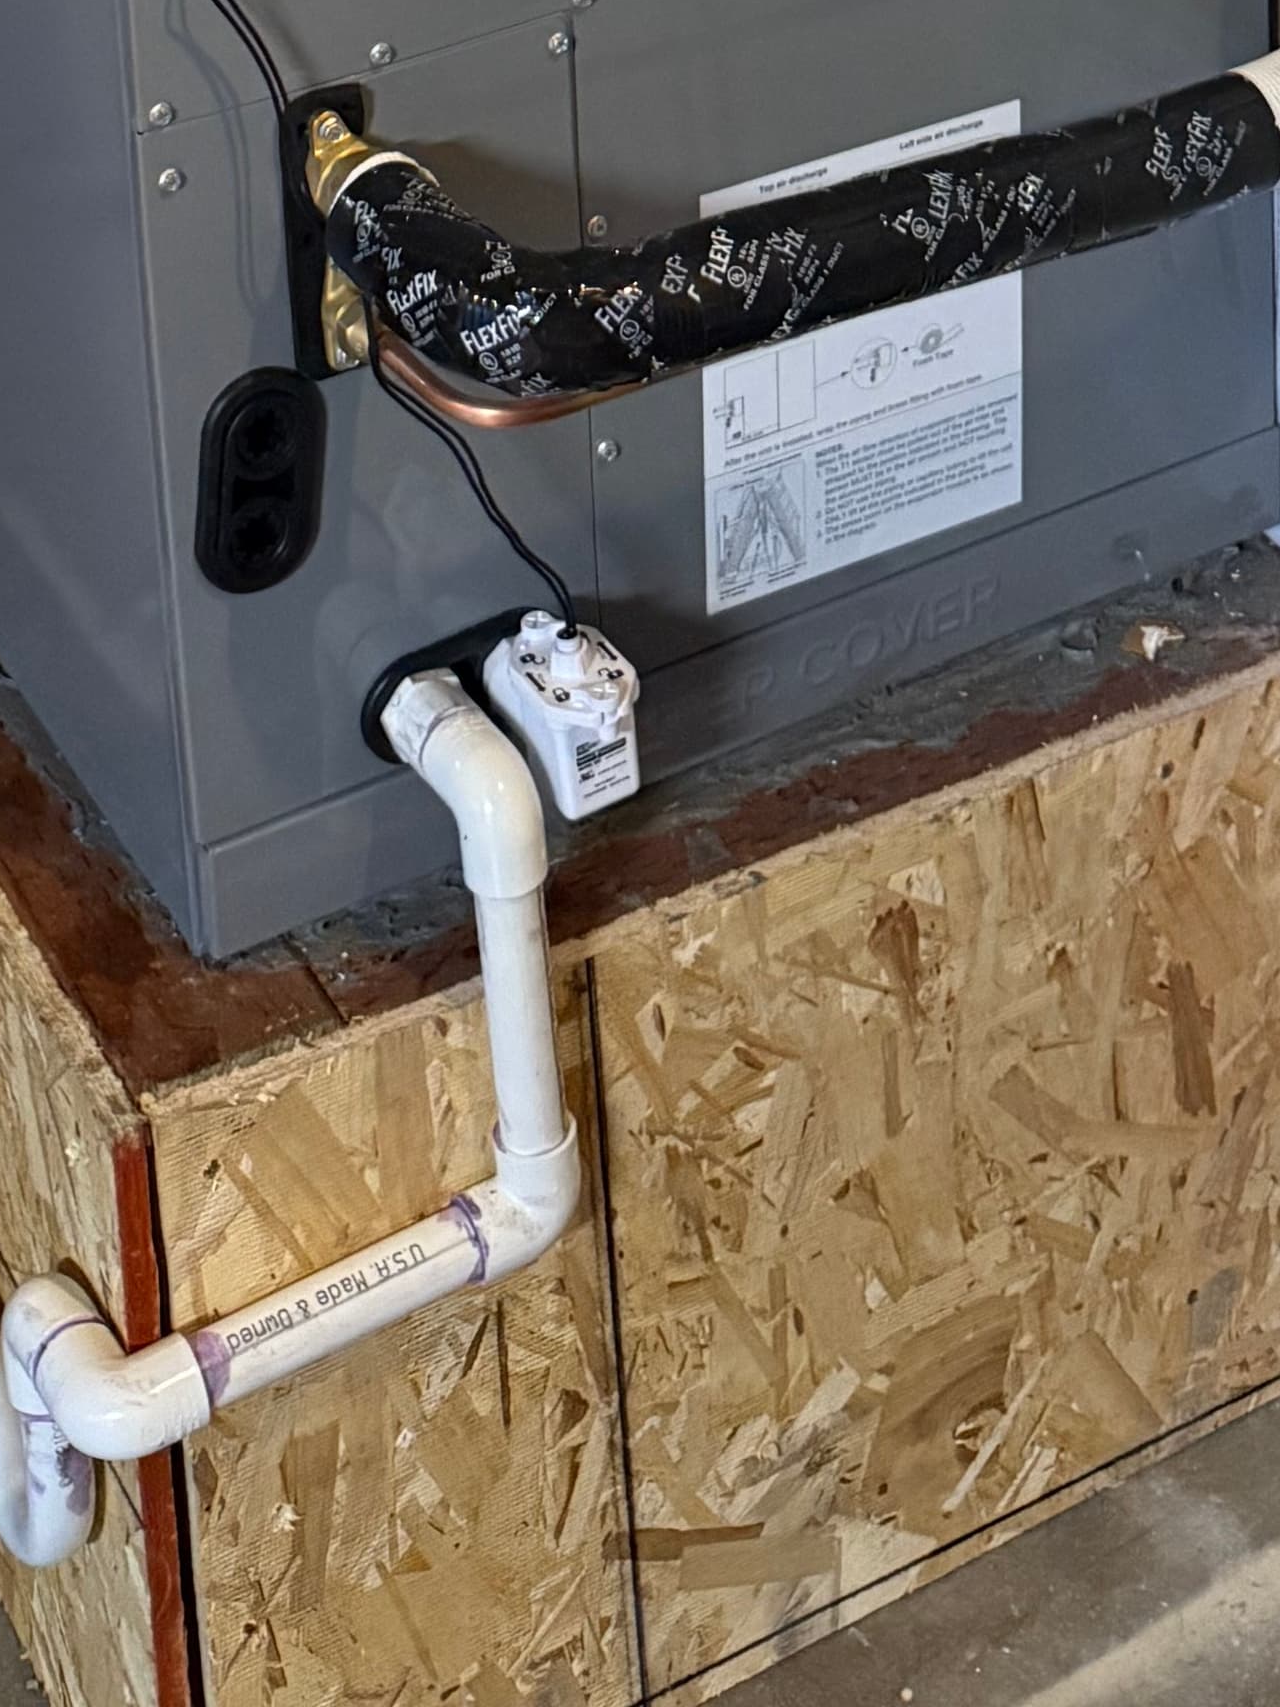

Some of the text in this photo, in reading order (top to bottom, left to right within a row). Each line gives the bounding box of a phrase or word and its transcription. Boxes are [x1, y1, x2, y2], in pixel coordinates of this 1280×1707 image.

[386, 270, 438, 315] FLEXFIX
[226, 1243, 426, 1353] U.S.A. Made & Owned
